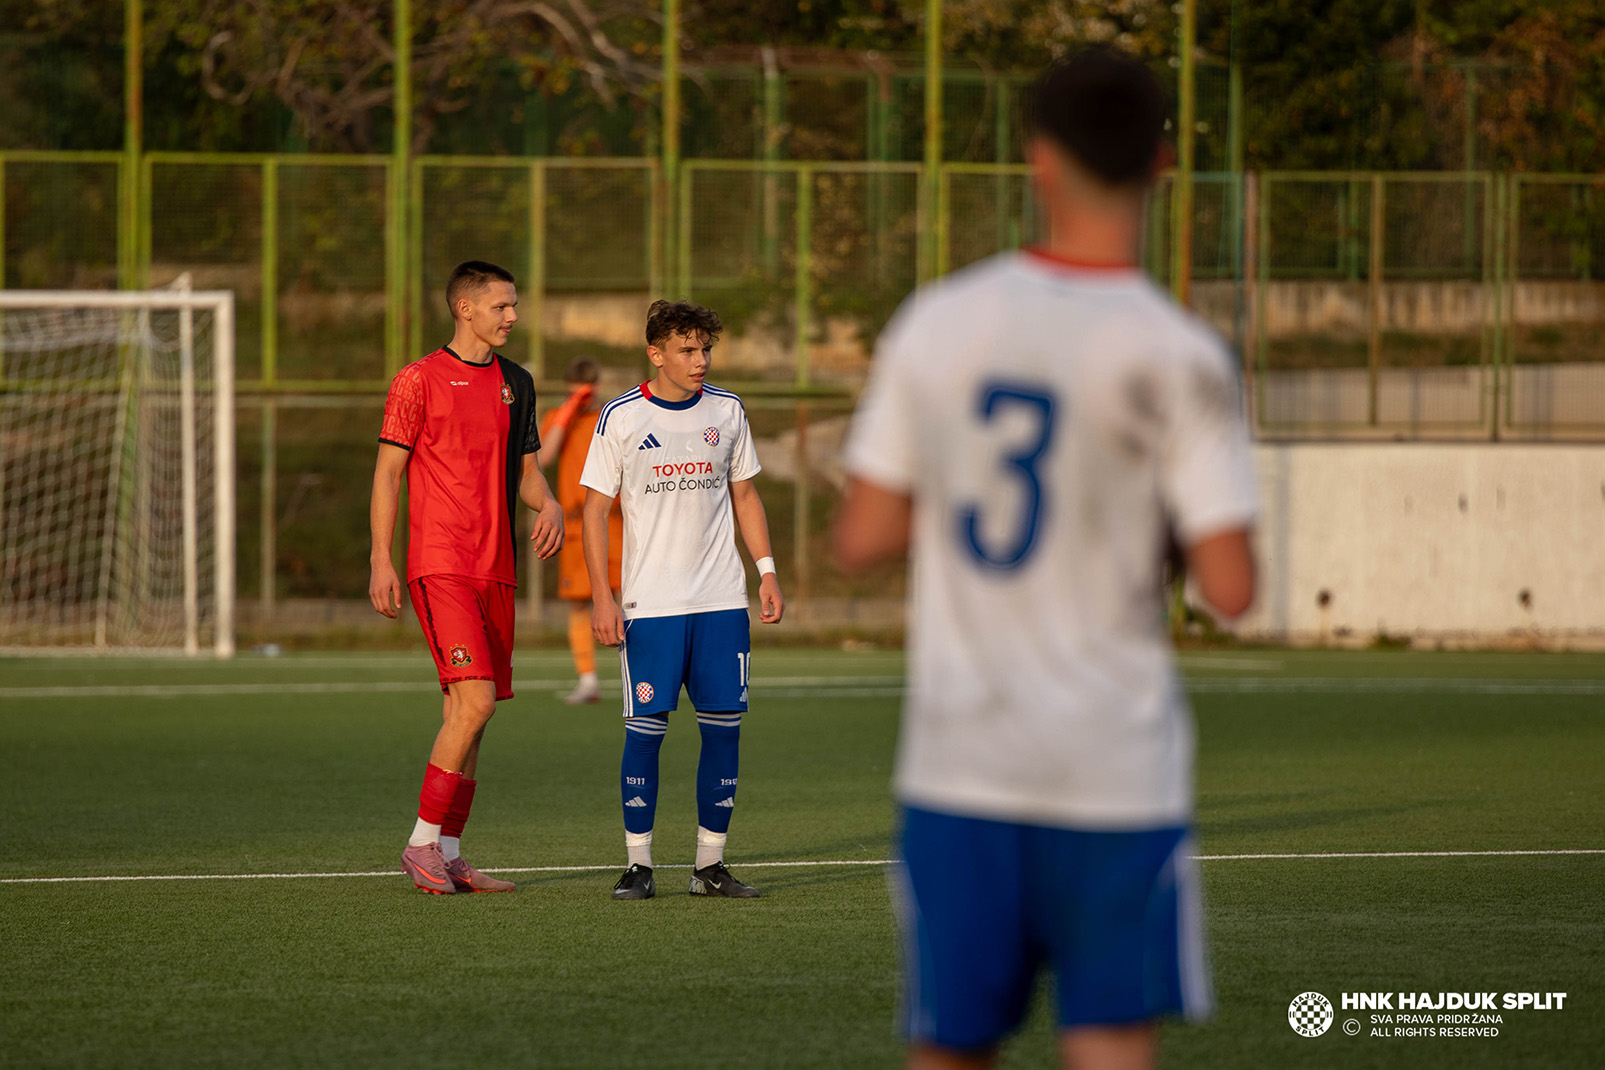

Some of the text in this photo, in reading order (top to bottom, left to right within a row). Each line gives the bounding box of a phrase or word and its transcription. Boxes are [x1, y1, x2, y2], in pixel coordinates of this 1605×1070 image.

[652, 462, 713, 477] TOYOTA
[957, 382, 1058, 572] 3
[644, 475, 721, 495] AUTO ČONDIĆ
[737, 652, 751, 687] 1
[626, 776, 645, 786] 1911
